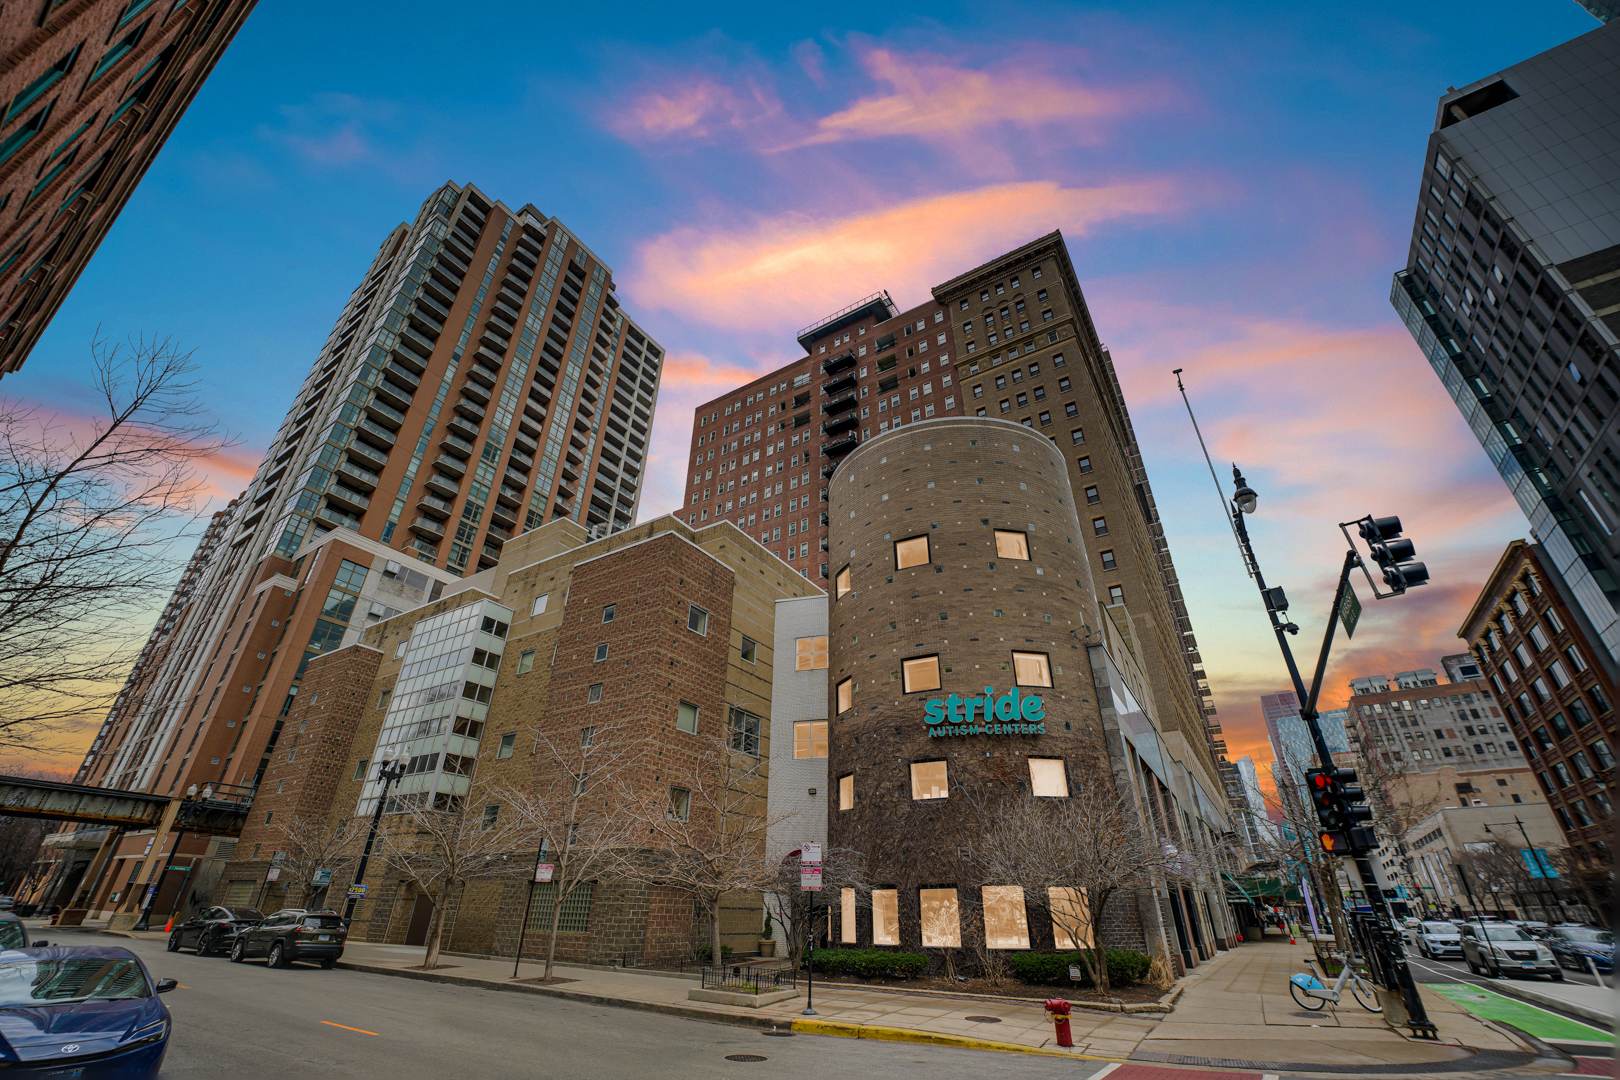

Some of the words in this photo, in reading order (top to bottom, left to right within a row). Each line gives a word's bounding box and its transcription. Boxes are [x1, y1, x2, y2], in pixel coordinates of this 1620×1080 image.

[924, 686, 1045, 724] stride
[928, 725, 979, 737] AUTISM
[985, 724, 1046, 735] CENTERS
